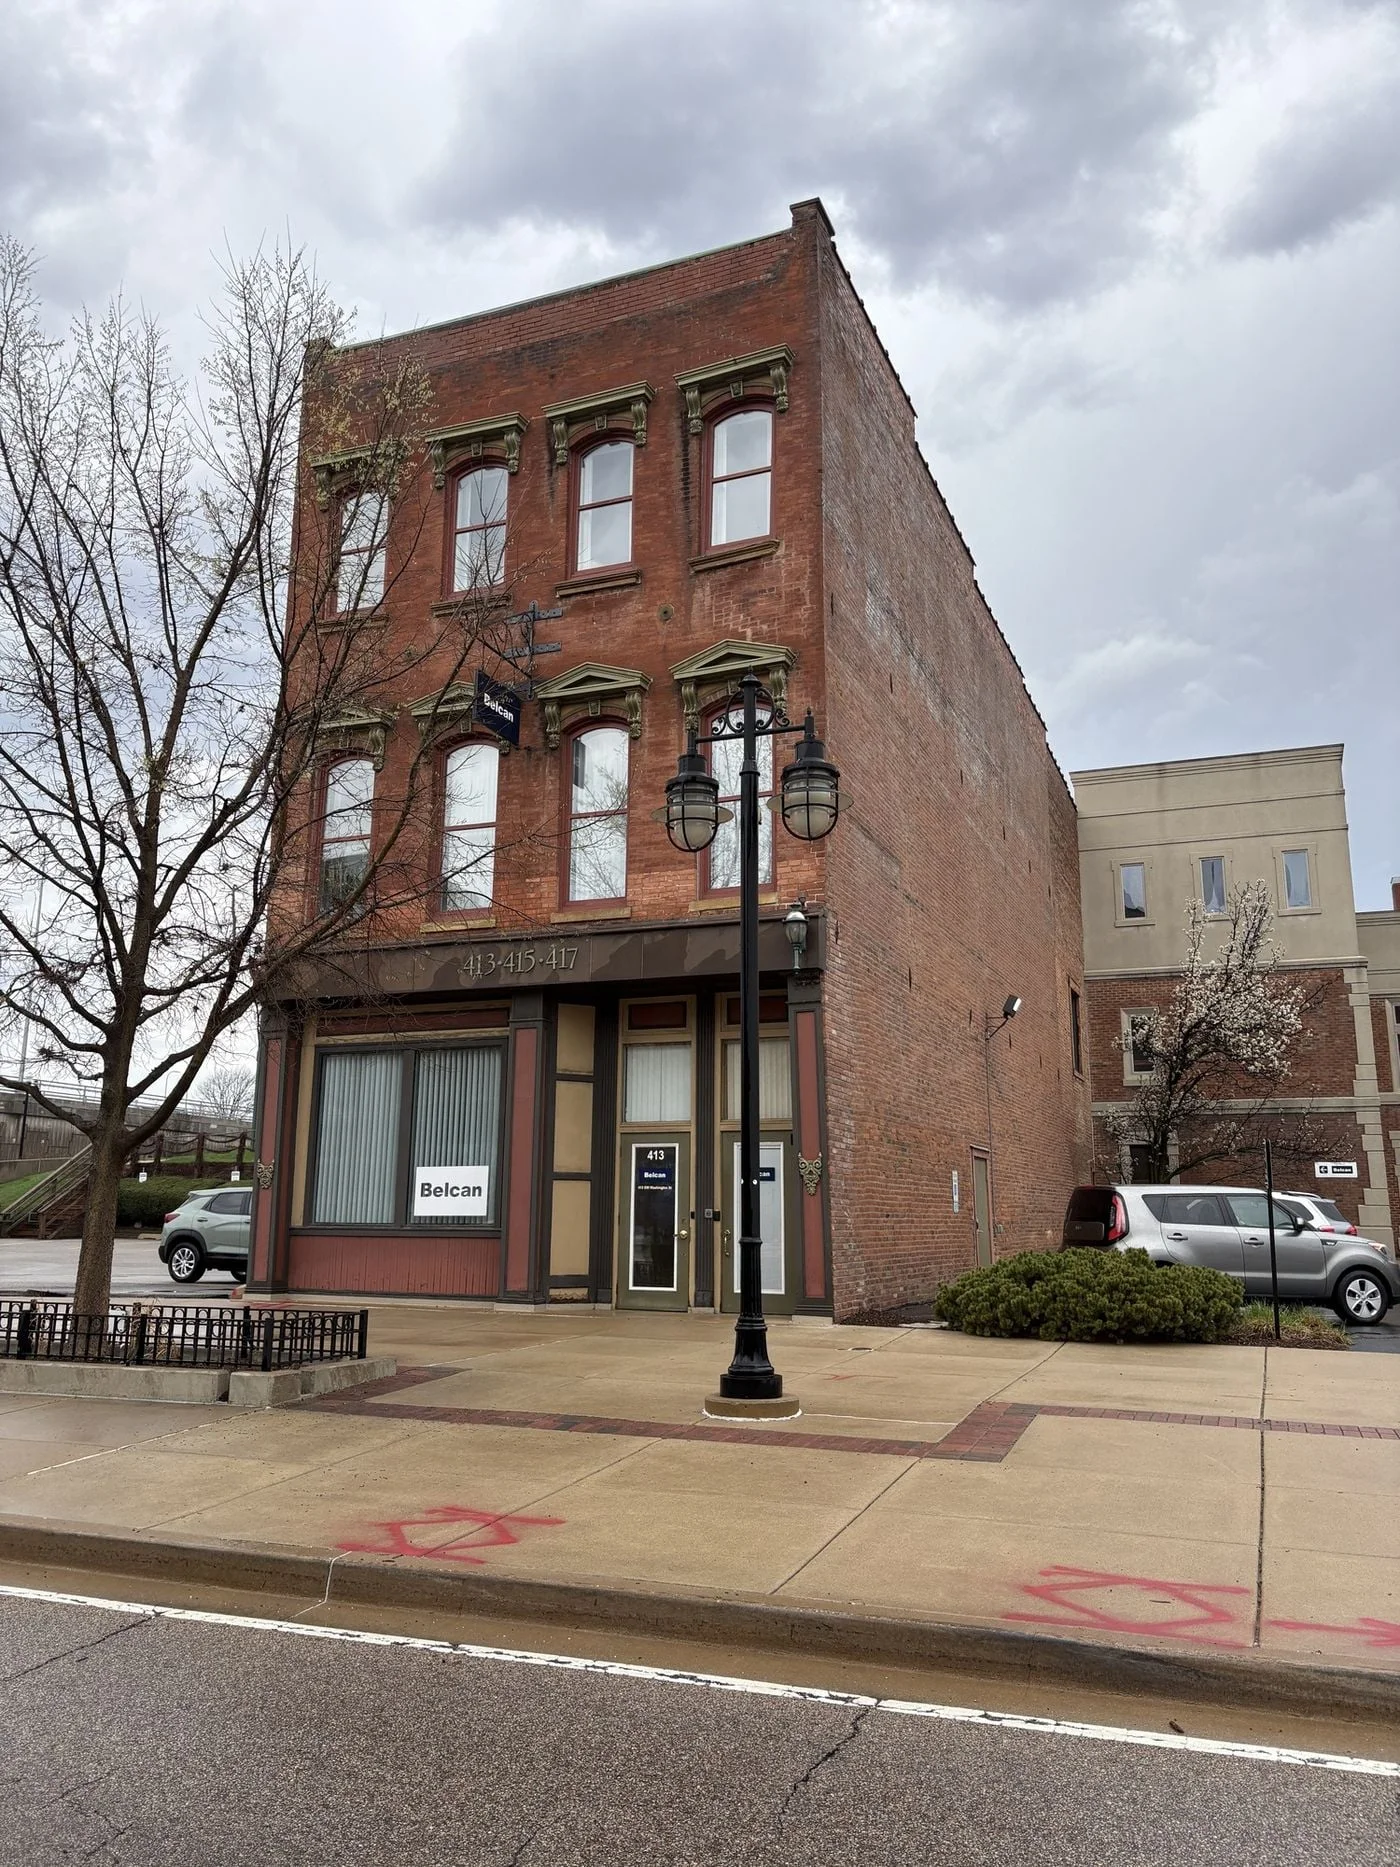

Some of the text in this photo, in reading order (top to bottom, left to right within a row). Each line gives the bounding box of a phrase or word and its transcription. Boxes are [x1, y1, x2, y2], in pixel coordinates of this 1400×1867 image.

[484, 693, 514, 723] Belcan
[647, 1150, 665, 1160] 413
[420, 1182, 482, 1198] Belcan
